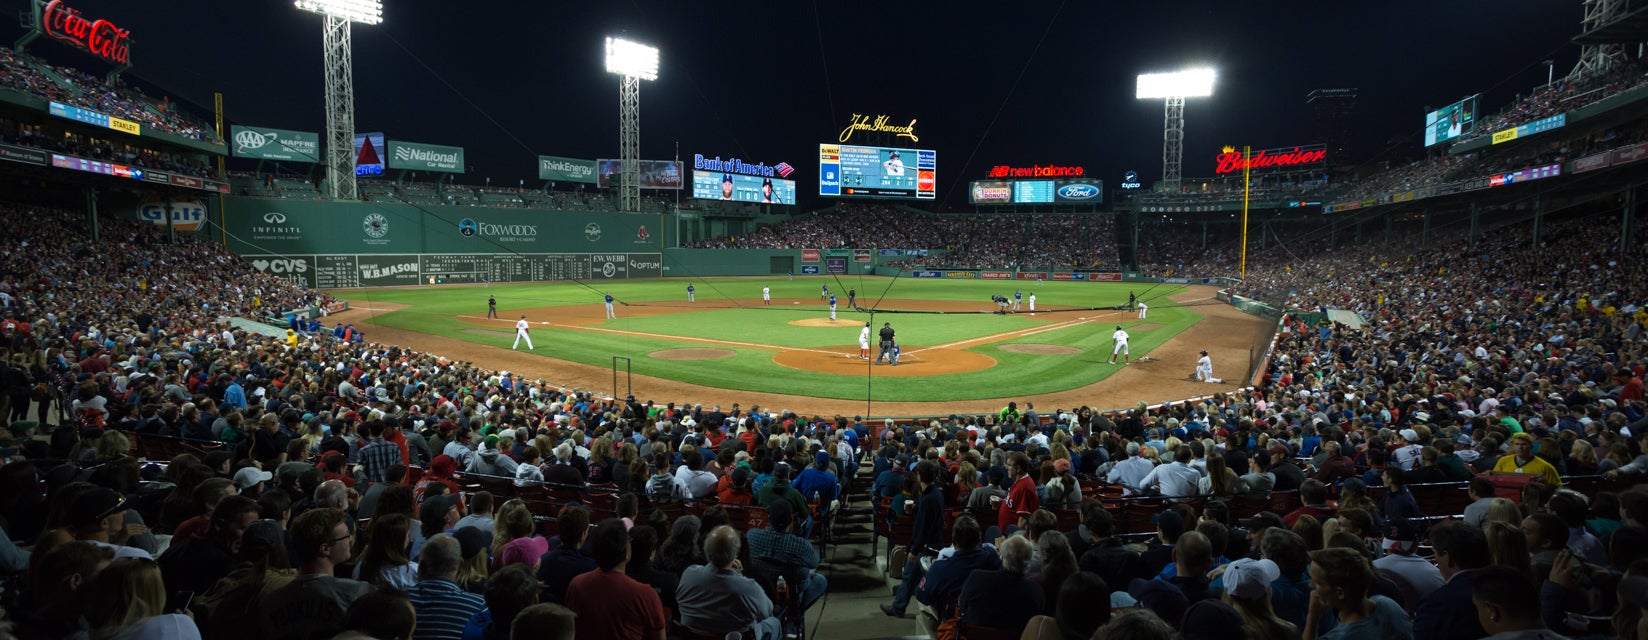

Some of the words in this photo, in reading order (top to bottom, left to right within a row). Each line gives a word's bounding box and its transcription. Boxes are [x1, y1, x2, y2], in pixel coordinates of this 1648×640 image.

[113, 120, 136, 132] STANLEY
[839, 112, 871, 142] John
[871, 114, 919, 142] Hancock
[238, 131, 262, 148] AAA
[280, 139, 315, 148] MAPFRE
[1494, 131, 1514, 142] STANLEY
[410, 149, 457, 163] National
[1215, 147, 1327, 174] Budweiser
[543, 160, 592, 176] ThinkEnergy
[694, 153, 723, 170] Bank
[723, 157, 735, 172] of
[735, 158, 775, 177] America
[1010, 167, 1033, 177] new
[1034, 164, 1084, 177] balance
[1066, 187, 1090, 197] Ford
[1121, 182, 1141, 190] tyco
[479, 222, 537, 236] FOXWOODS
[270, 259, 307, 273] CVS
[748, 519, 763, 527] 47
